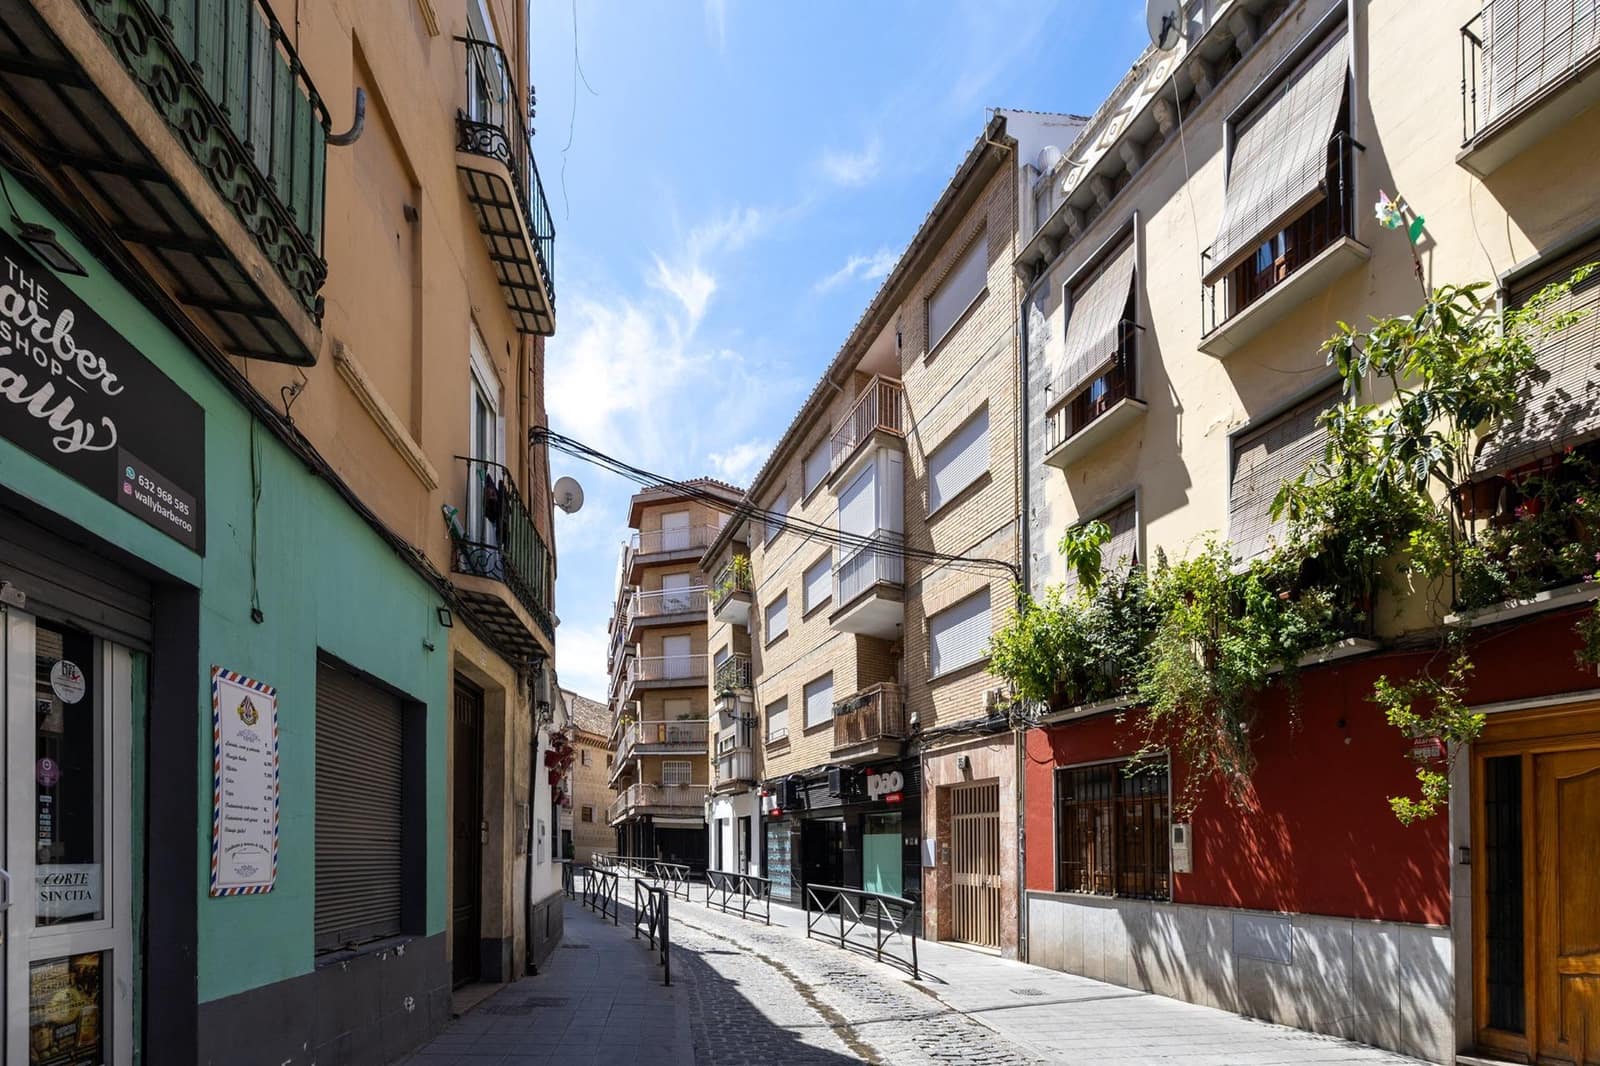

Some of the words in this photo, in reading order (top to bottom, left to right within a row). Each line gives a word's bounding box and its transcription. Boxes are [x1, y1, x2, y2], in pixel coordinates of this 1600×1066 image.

[4, 256, 49, 310] THE
[0, 285, 125, 396] arber
[0, 320, 63, 377] SHOP
[0, 346, 118, 454] ally
[134, 489, 193, 532] wallybarberoo
[138, 475, 156, 494] 632
[156, 487, 173, 505] 968
[174, 498, 189, 516] 585
[40, 890, 62, 902] SIN
[64, 890, 92, 901] CITA
[43, 872, 89, 885] CORTE
